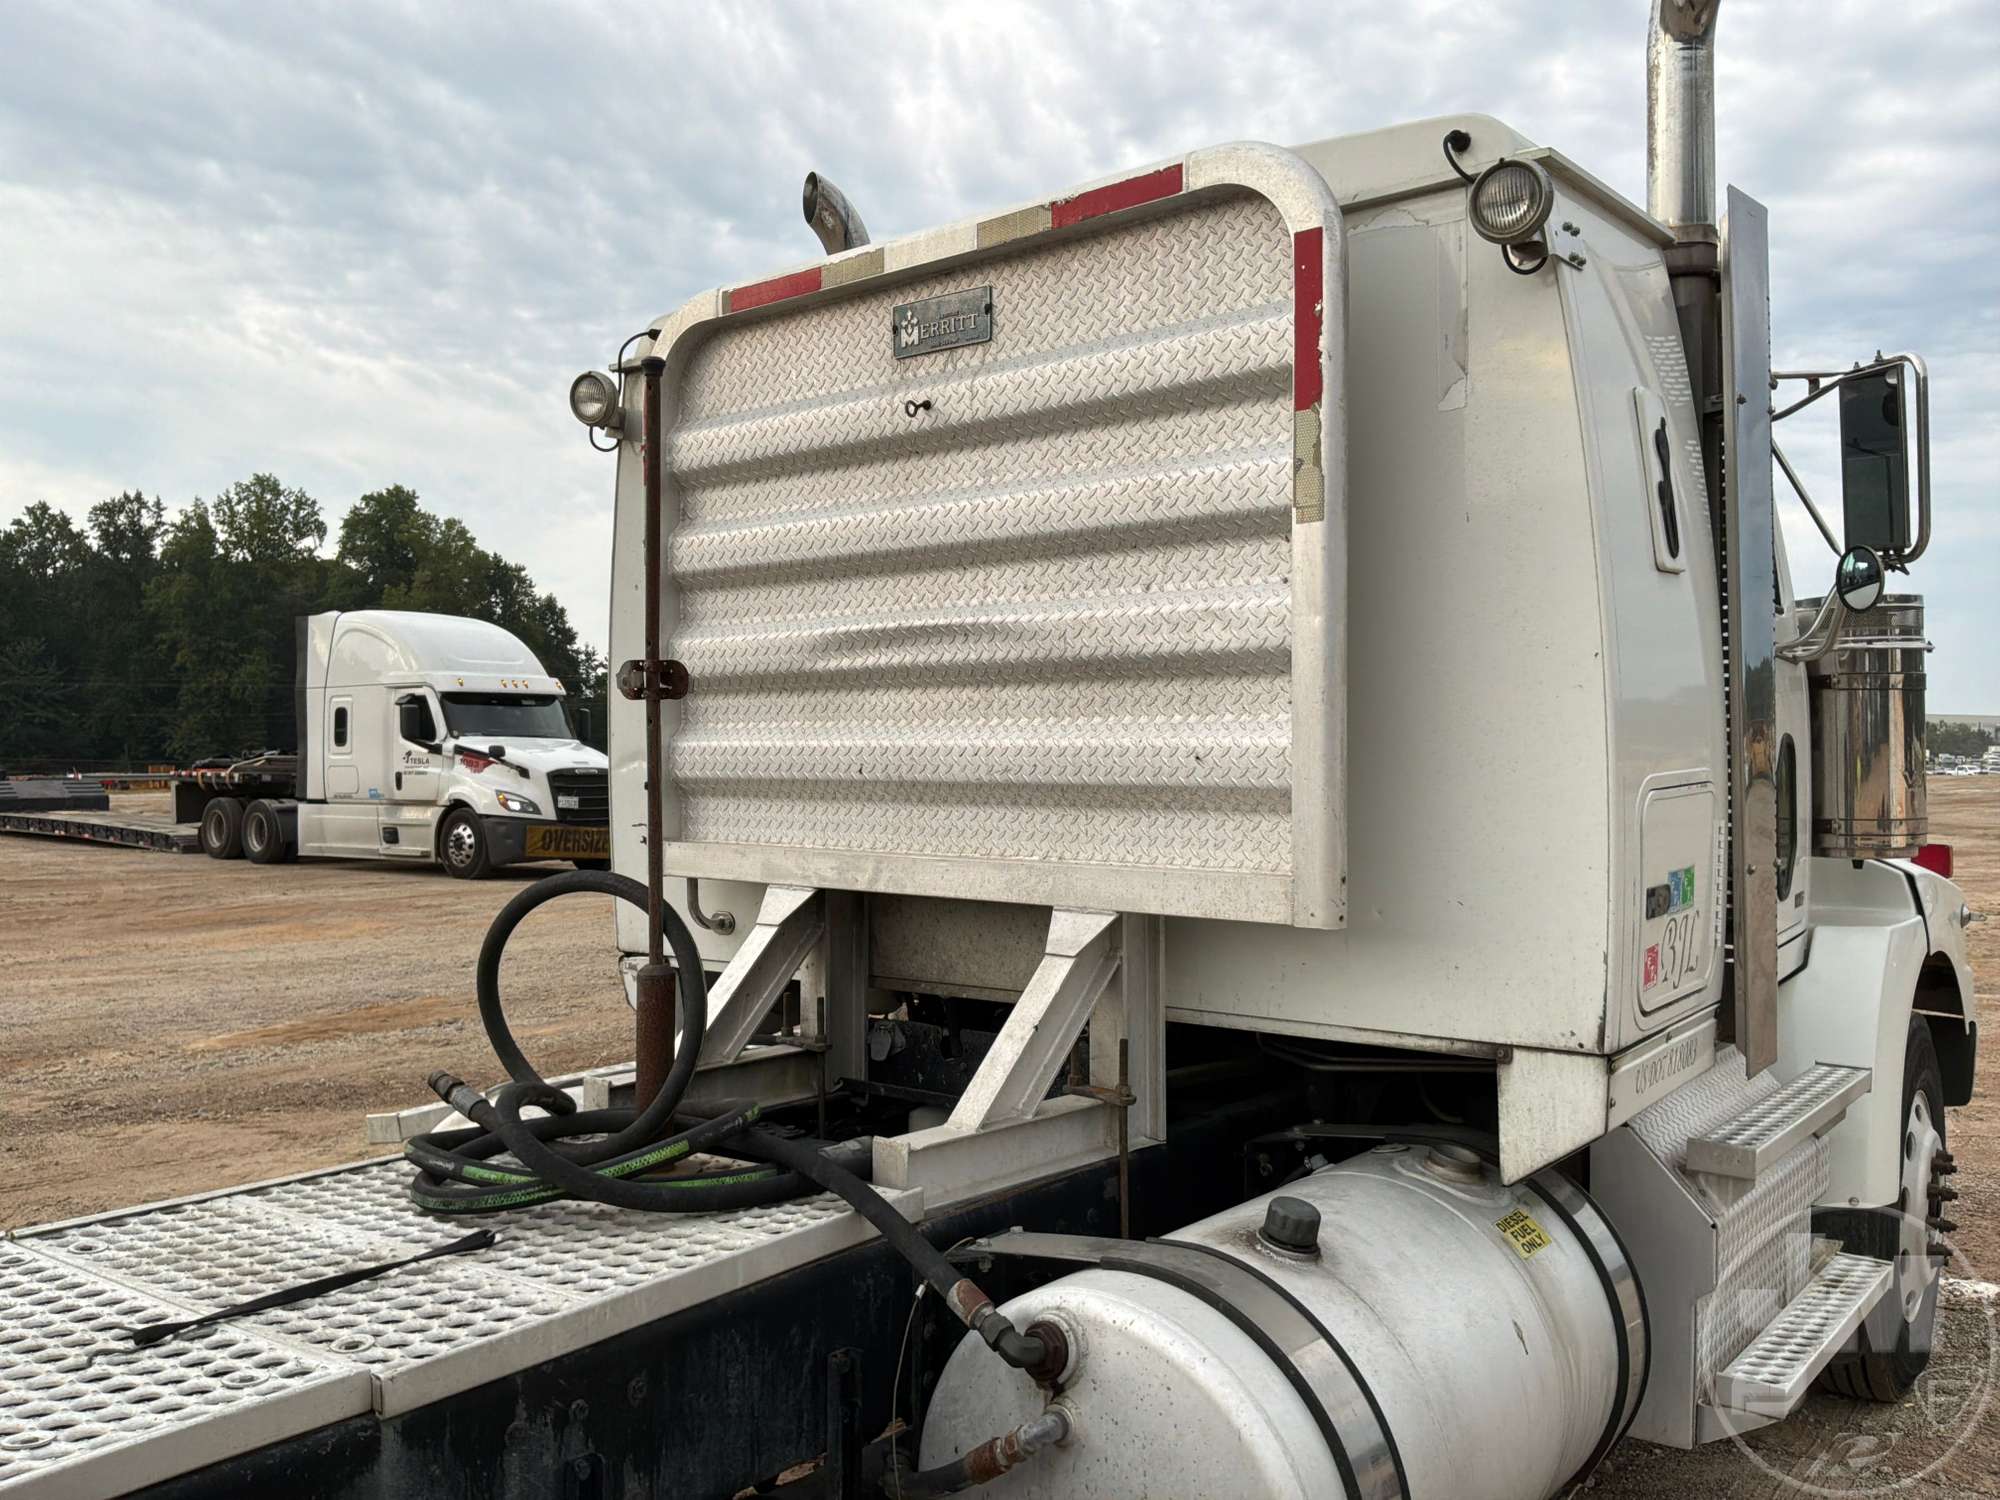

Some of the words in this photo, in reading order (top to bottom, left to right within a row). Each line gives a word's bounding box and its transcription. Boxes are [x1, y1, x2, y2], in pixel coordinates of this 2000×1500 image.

[901, 313, 978, 348] MERRITT
[410, 757, 430, 765] TESLA
[1496, 1211, 1528, 1233] DIESEL
[1511, 1223, 1536, 1242] FUEL
[1521, 1232, 1545, 1254] ONLY
